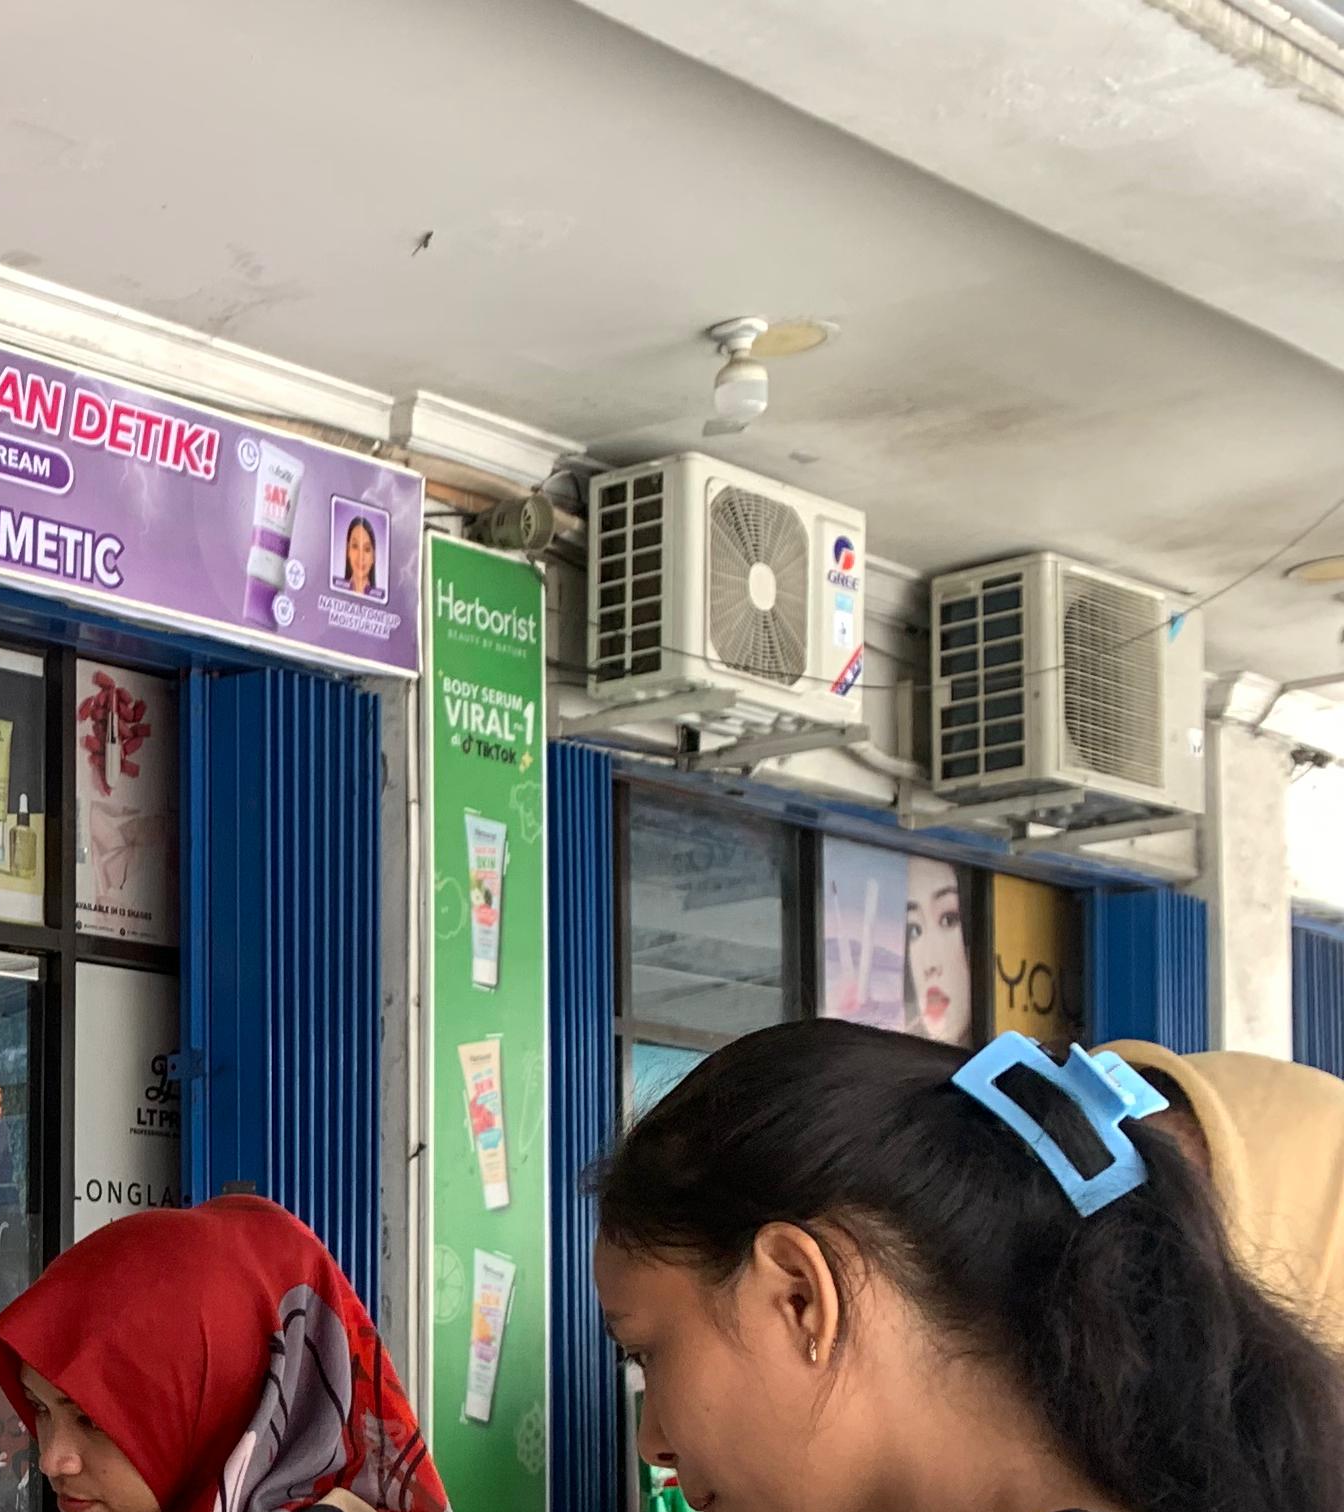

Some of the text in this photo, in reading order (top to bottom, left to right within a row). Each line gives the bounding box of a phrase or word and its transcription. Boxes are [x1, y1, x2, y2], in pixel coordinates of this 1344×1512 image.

[71, 391, 219, 477] DETIK!
[827, 569, 859, 592] GREE
[318, 594, 362, 616] NATURAL
[437, 578, 537, 645] Herborist
[329, 609, 390, 639] MOISTURIZER
[443, 676, 523, 712] BODY SERUM
[444, 695, 515, 742] VIRAL
[75, 902, 109, 914] AVAILABLE
[137, 1107, 181, 1129] LT PR
[75, 1179, 175, 1207] ONGLA
